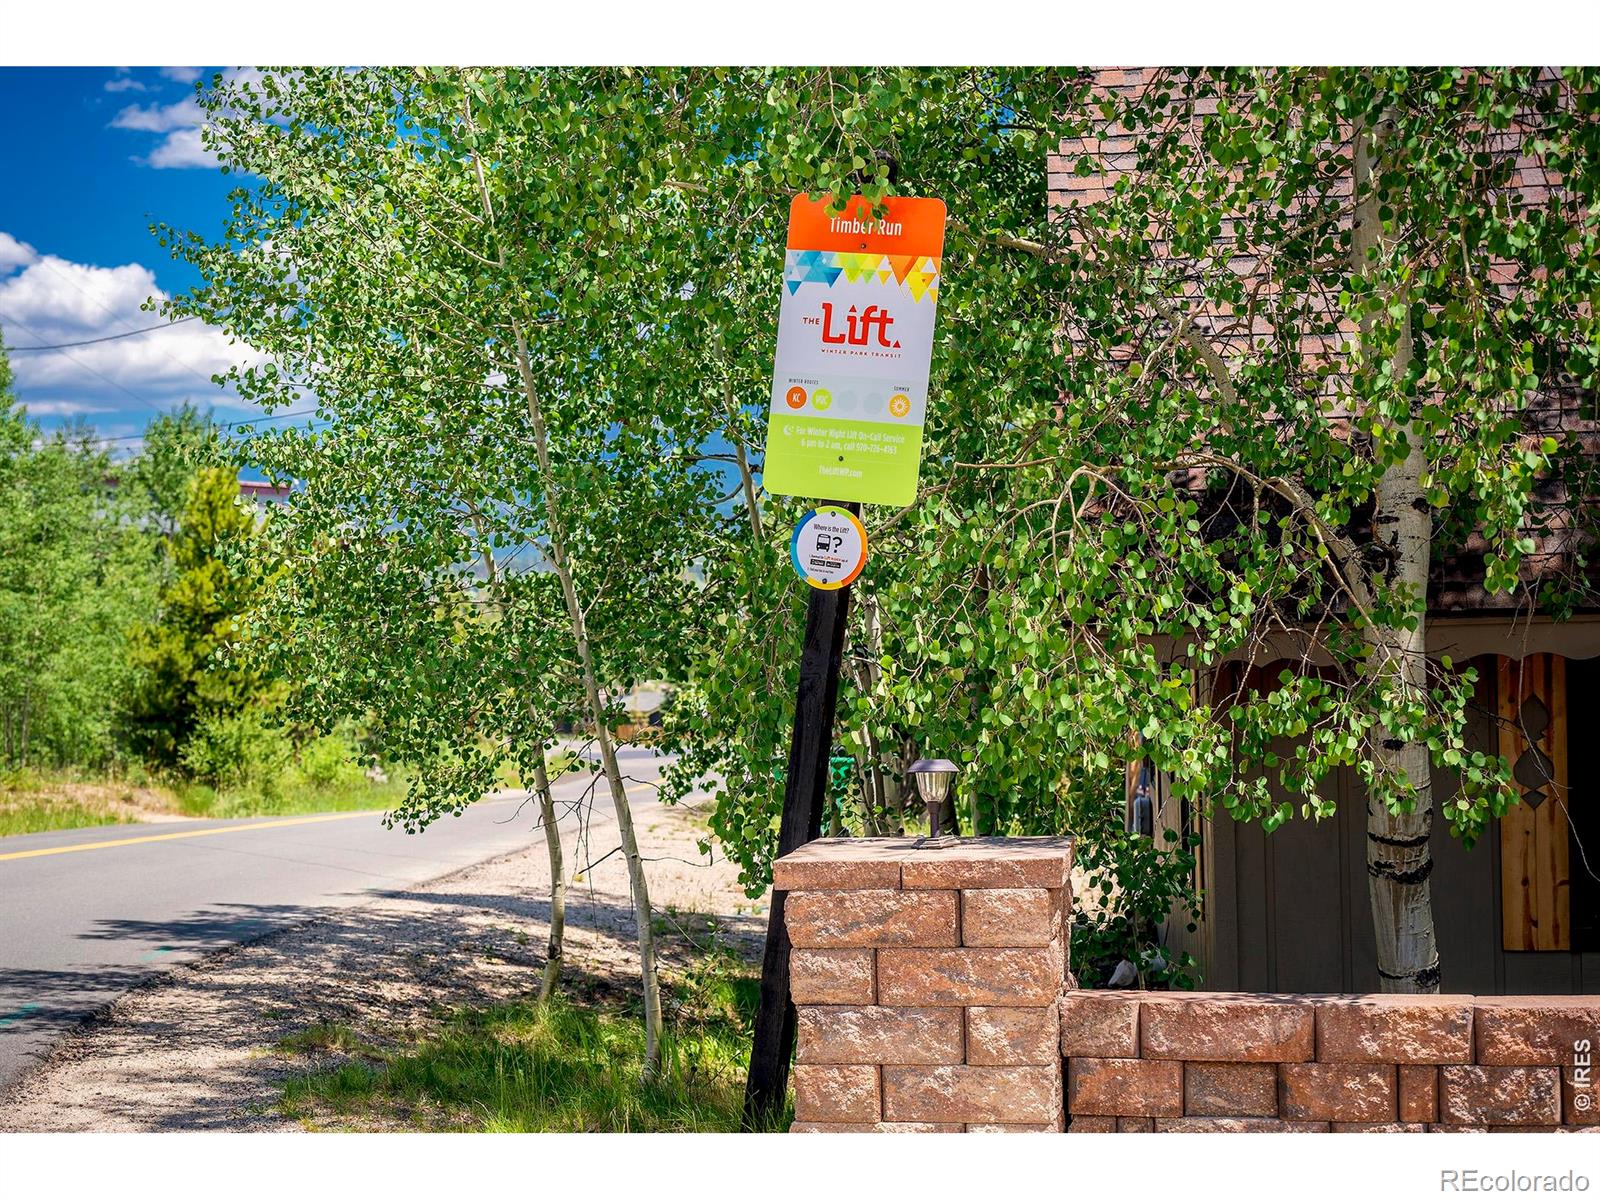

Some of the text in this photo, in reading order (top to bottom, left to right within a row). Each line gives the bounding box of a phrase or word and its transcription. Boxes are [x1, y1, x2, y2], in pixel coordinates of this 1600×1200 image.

[830, 217, 903, 236] Timber Run
[803, 316, 820, 326] THE
[871, 351, 902, 359] TRANSIT
[792, 392, 801, 403] KC
[814, 524, 828, 532] Where
[832, 536, 843, 553] ?
